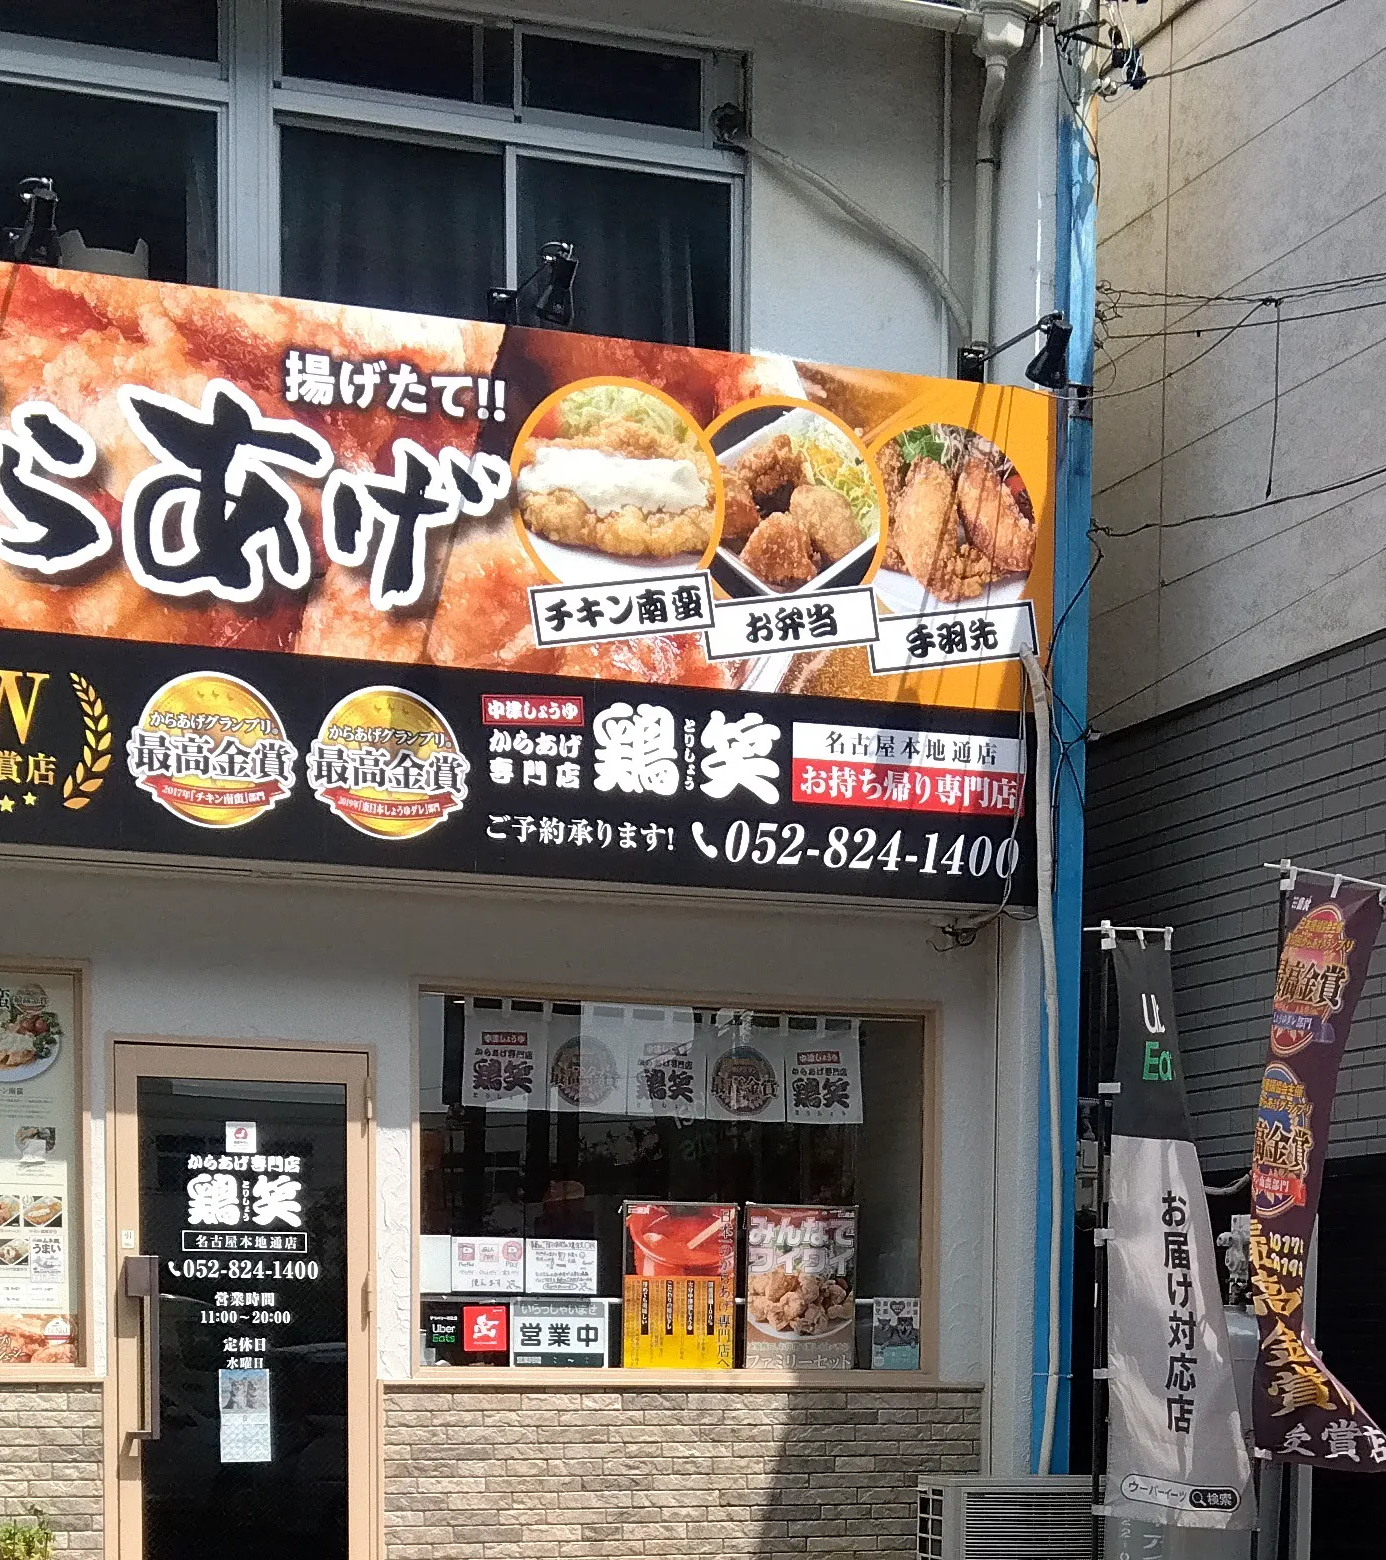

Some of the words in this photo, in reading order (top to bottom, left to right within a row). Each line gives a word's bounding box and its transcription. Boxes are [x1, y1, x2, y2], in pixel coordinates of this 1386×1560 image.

[543, 587, 704, 630] チキン南蛮
[744, 612, 838, 643] お弁当
[905, 621, 998, 660] 手羽先
[488, 700, 578, 720] 中津しょうゆ
[132, 732, 292, 784] 最高金賞
[489, 729, 583, 758] からあげ
[593, 702, 781, 805] 鶏笑
[684, 718, 696, 791] とりしょう
[825, 730, 998, 765] 名古屋本地通店
[311, 747, 466, 795] 最高金賞
[489, 757, 581, 789] 専門店
[800, 765, 1018, 810] お持ち帰り専門店
[725, 820, 1020, 879] 052-824-1400
[1142, 1041, 1174, 1080] Ea
[1254, 1121, 1311, 1171] 高金賞
[188, 1154, 301, 1172] からあげ専門店
[187, 1173, 302, 1227] 鶏笑
[195, 1235, 297, 1250] 名古屋本地通店
[749, 1216, 855, 1247] みんなで
[183, 1259, 318, 1279] 052-824-1400
[214, 1292, 275, 1307] 営業時間
[521, 1305, 598, 1316] いらっしゃいませ
[1160, 1190, 1196, 1435] お届け対応店
[432, 1324, 456, 1333] Uber
[432, 1335, 456, 1343] Eats
[520, 1322, 598, 1347] 営業中
[223, 1337, 266, 1352] 定休日
[226, 1357, 264, 1370] 水曜日
[746, 1353, 851, 1368] ファミリーセット
[1128, 1481, 1187, 1503] ウーバーイーツ
[1207, 1493, 1232, 1506] 検索
